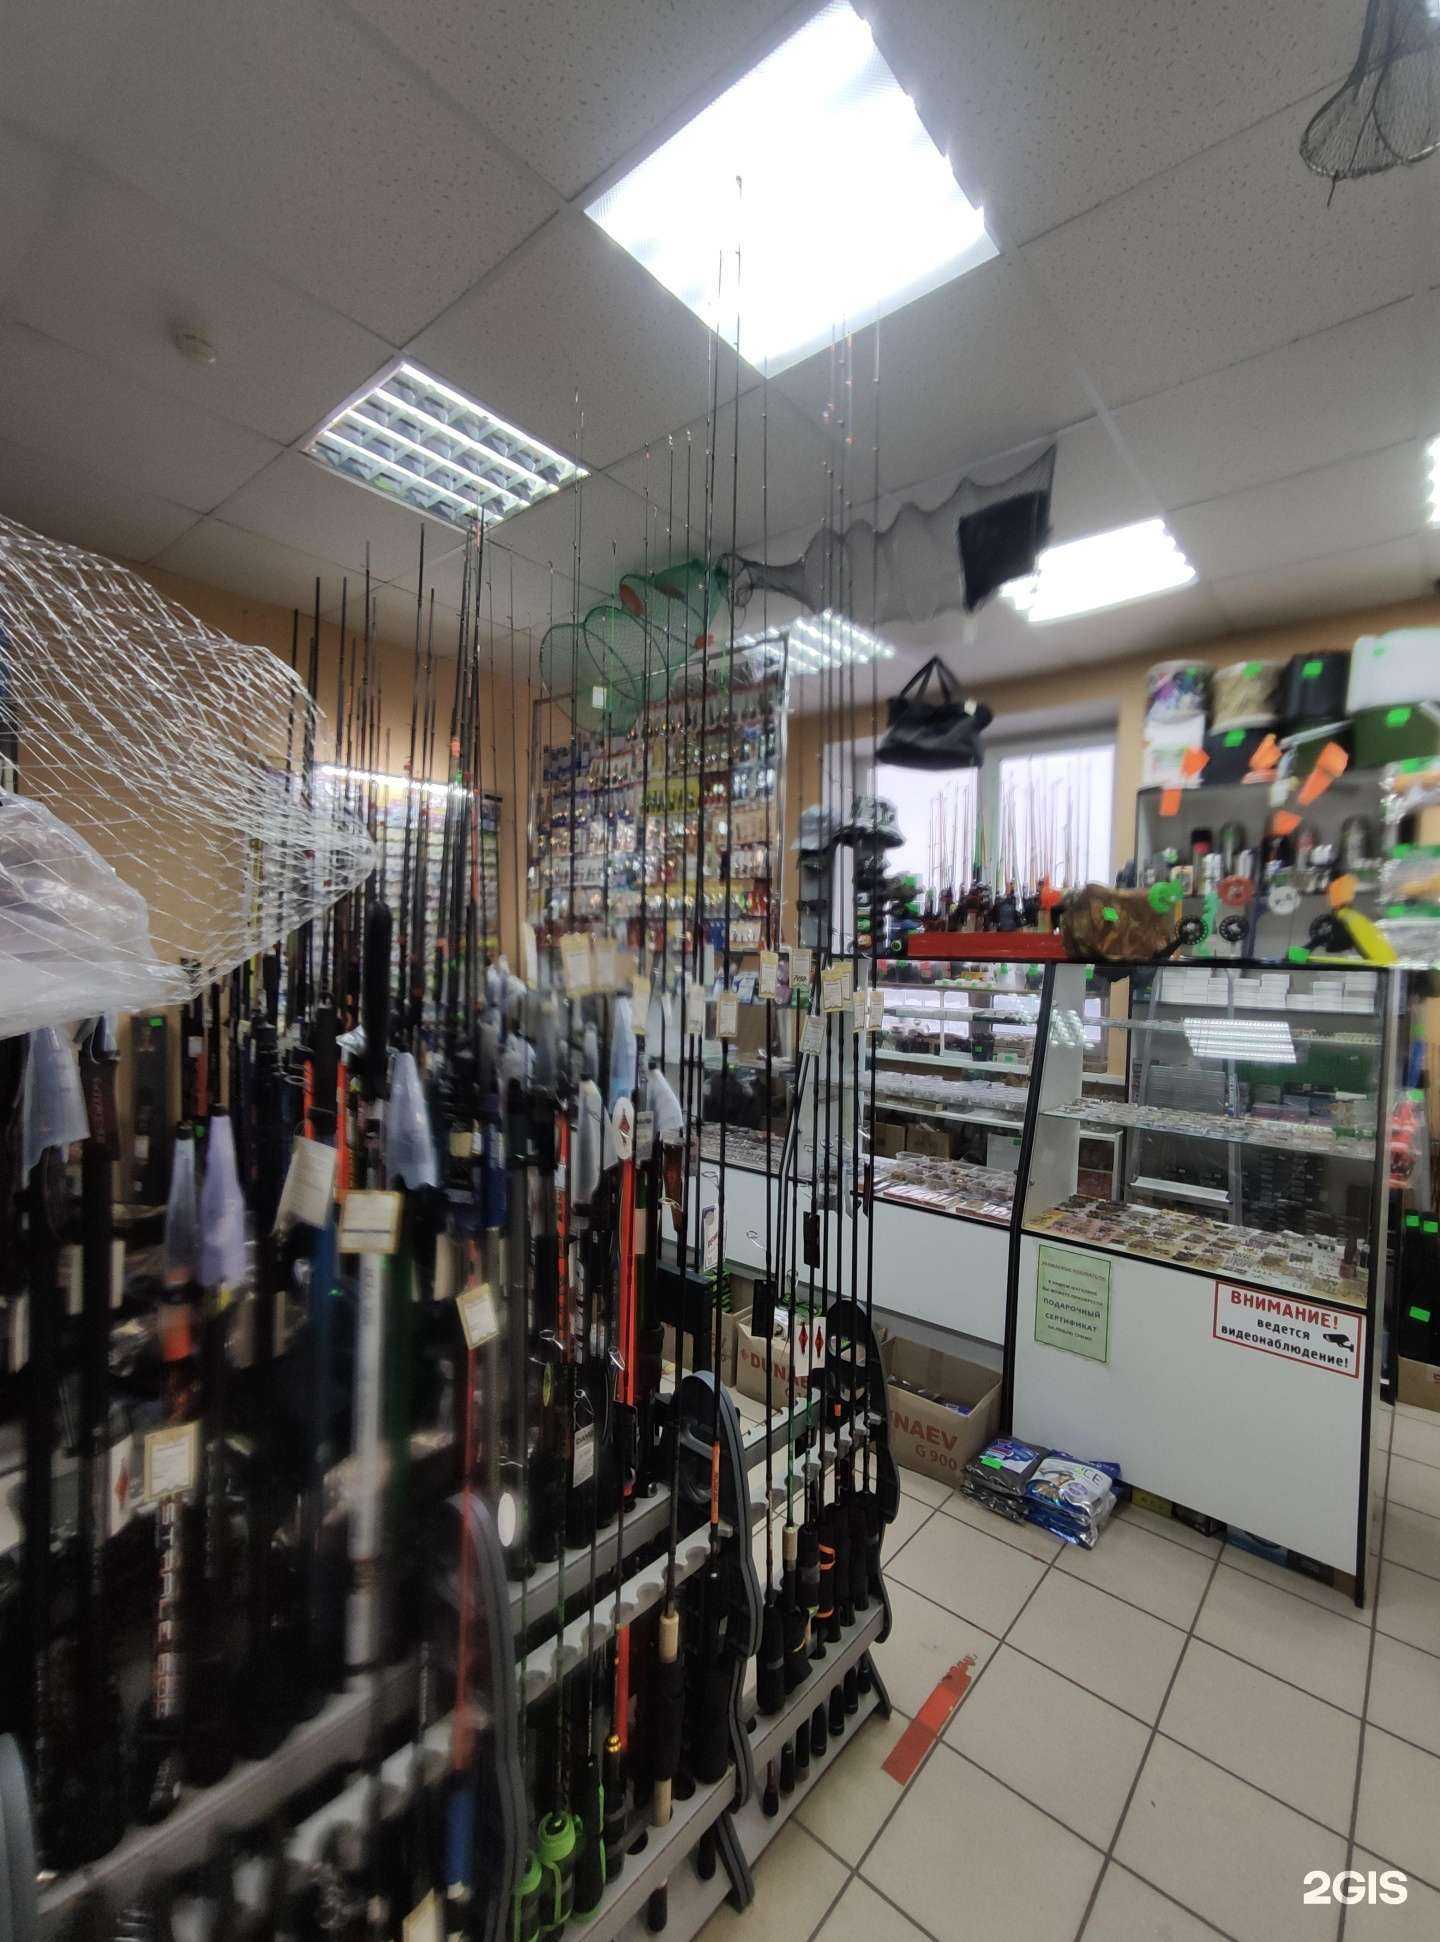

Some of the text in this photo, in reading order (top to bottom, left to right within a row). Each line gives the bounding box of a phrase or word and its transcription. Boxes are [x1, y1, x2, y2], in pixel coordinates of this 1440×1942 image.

[1042, 1297, 1101, 1319] ПОДАРОЧНЫЙ
[1231, 1290, 1339, 1330] ВНИМАНИЕ!
[1045, 1312, 1097, 1333] СЕРТИФИКАТ
[1257, 1318, 1311, 1341] ведется
[1221, 1325, 1349, 1369] видеонаблюдение!
[892, 1410, 958, 1452] NAEV
[915, 1444, 958, 1471] G 900
